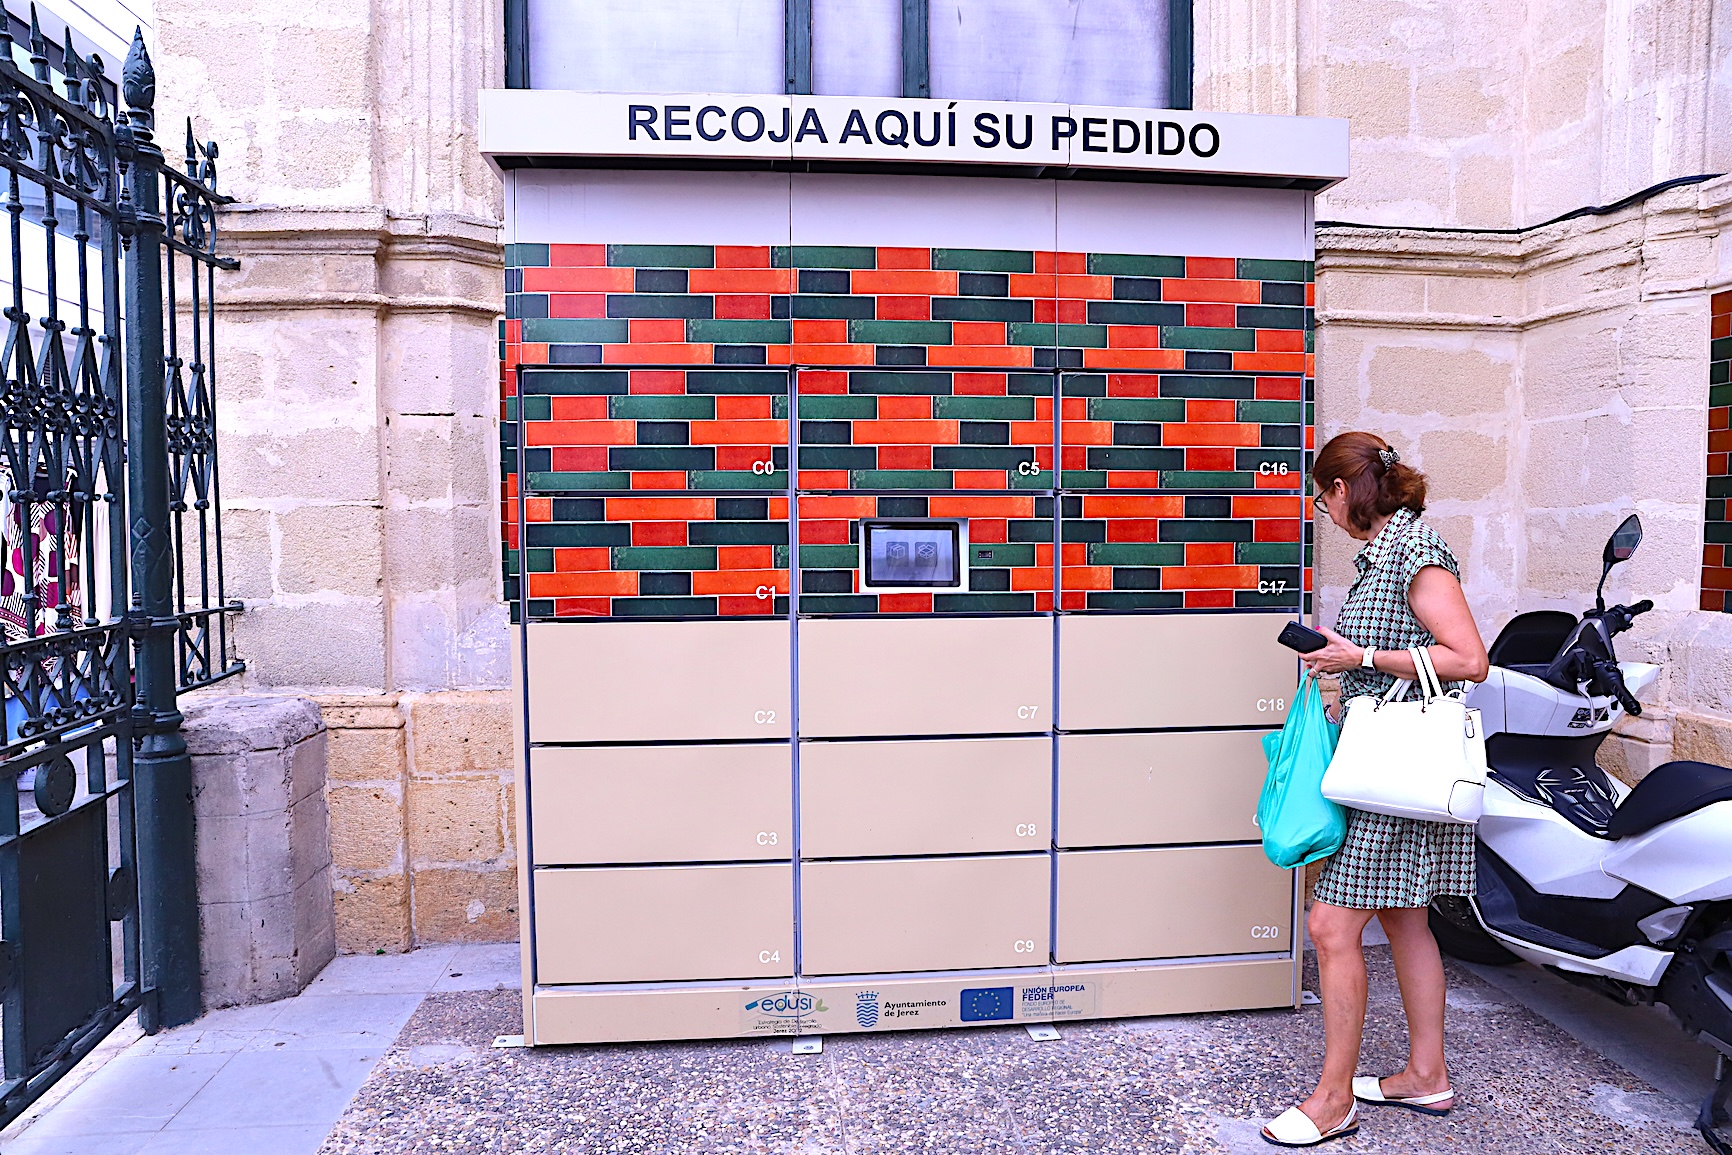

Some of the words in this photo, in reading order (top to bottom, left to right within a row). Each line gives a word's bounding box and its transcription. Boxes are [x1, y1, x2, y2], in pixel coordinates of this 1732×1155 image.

[628, 104, 828, 144] RECOJA
[838, 102, 957, 148] AQUÍ
[973, 112, 1032, 150] SU
[1051, 115, 1220, 158] PEDIDO
[752, 461, 774, 475] C0
[1018, 462, 1040, 476] C5
[1259, 462, 1288, 476] C16
[756, 586, 776, 600] C1
[1258, 581, 1287, 595] C17
[1017, 705, 1039, 719] C7
[1256, 699, 1285, 712] C18
[754, 710, 776, 724] C2
[1015, 823, 1037, 837] C8
[756, 832, 778, 846] C3
[1251, 926, 1279, 939] C20
[1014, 940, 1035, 954] C9
[759, 950, 781, 964] C4
[1022, 986, 1047, 994] UNIÓN
[1049, 985, 1085, 993] EUROPEA
[761, 995, 811, 1012] edusi
[1022, 993, 1054, 1001] FEDER
[884, 999, 946, 1010] Ayuntamiento
[896, 1009, 919, 1018] Jerez
